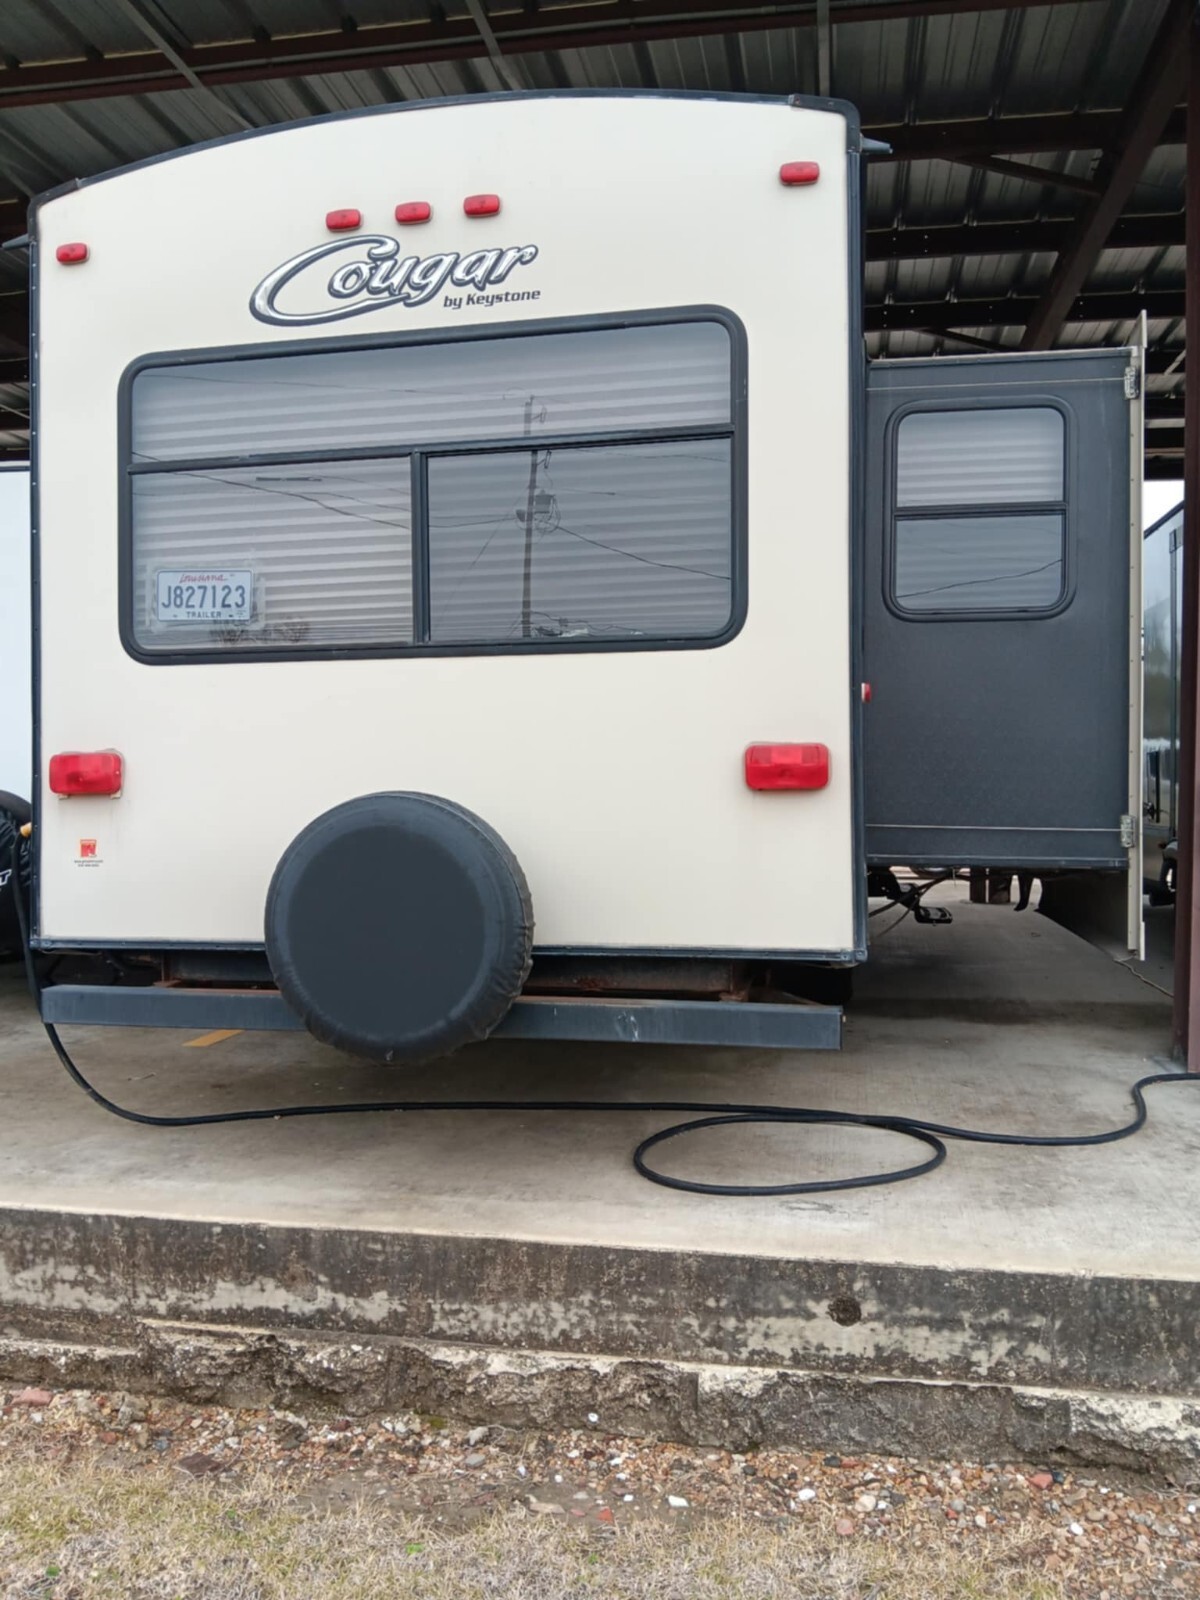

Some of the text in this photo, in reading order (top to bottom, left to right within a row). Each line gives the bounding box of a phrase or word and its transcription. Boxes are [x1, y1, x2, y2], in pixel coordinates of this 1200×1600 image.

[250, 234, 538, 327] Cougar
[443, 290, 541, 310] by Keystone
[161, 584, 246, 609] J827123
[186, 611, 222, 619] TRAILER
